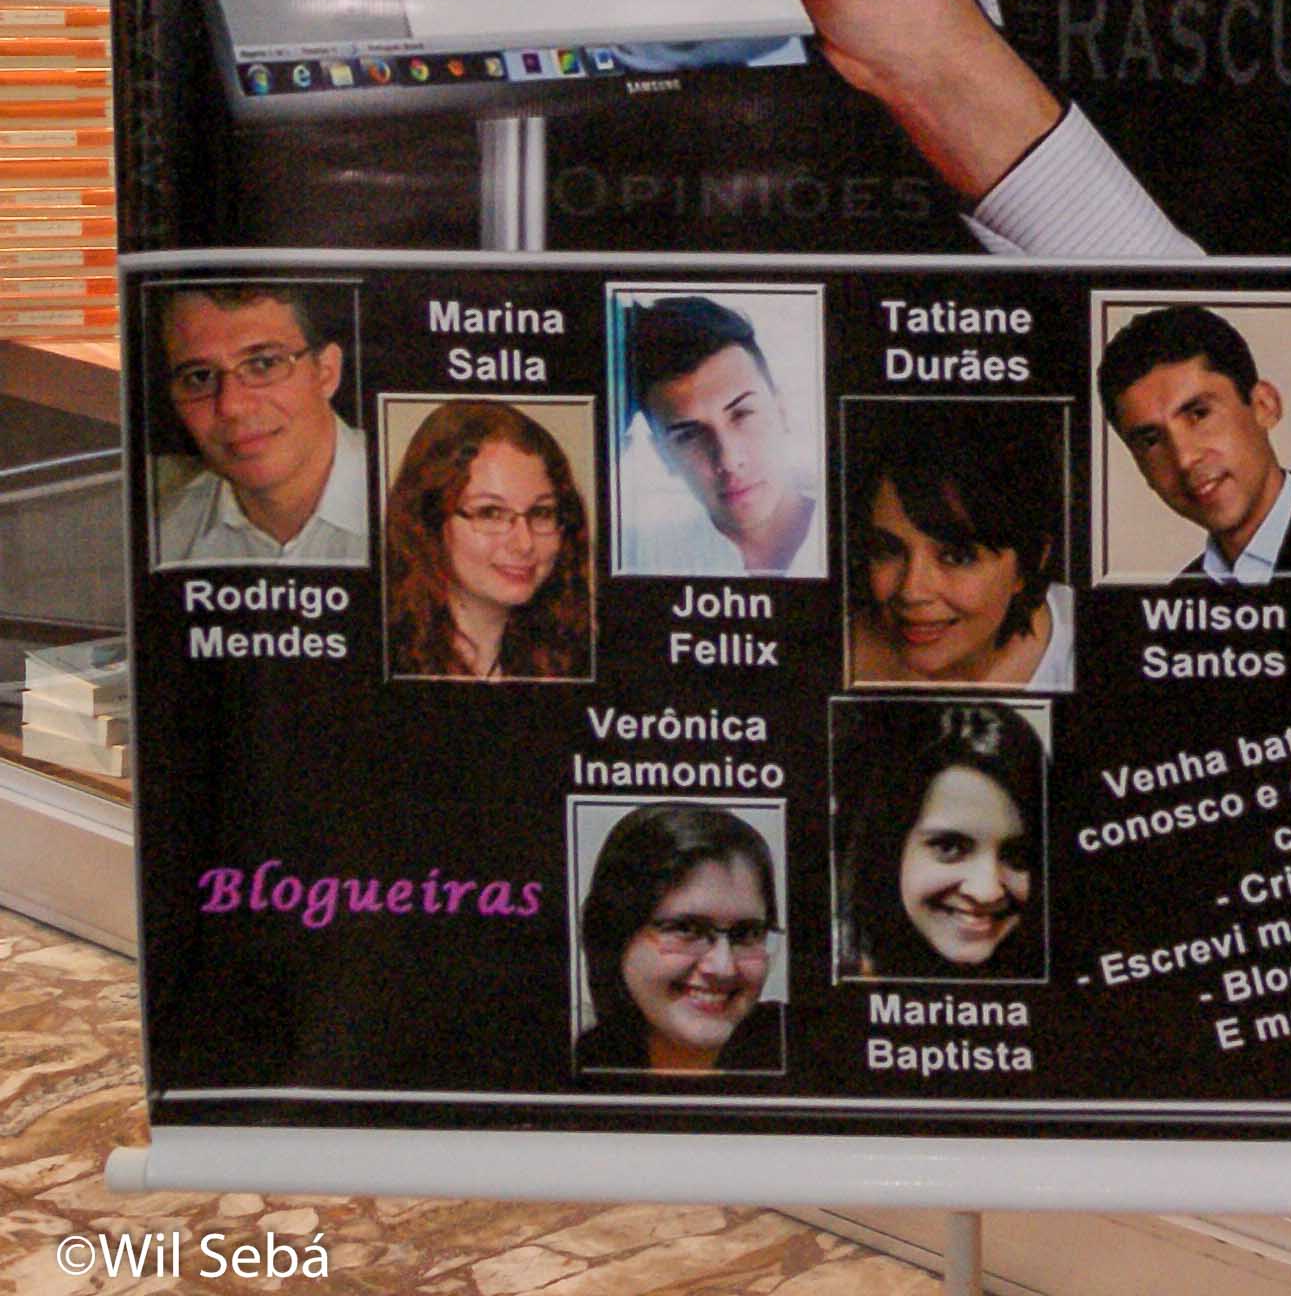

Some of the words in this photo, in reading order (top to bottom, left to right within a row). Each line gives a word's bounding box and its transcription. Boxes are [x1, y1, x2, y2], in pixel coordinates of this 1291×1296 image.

[428, 301, 565, 335] Marina
[881, 299, 1034, 336] Tatiane
[447, 347, 547, 384] Salla
[884, 347, 1032, 384] Durães
[184, 580, 350, 619] Rodrigo
[672, 585, 773, 621] John
[1142, 598, 1287, 632] Wilson
[188, 626, 348, 659] Mendes
[668, 631, 780, 667] Fellix
[1142, 645, 1287, 680] Santos
[587, 707, 768, 743] Verônica
[572, 753, 785, 790] Inamonico
[1102, 746, 1230, 803] Venha
[1077, 790, 1246, 853] conosco
[1255, 785, 1278, 811] e
[199, 859, 543, 930] Blogueiras
[1100, 922, 1248, 989] Escrevi
[868, 994, 1029, 1029] Mariana
[1215, 1017, 1244, 1052] E
[866, 1039, 1034, 1079] Baptista
